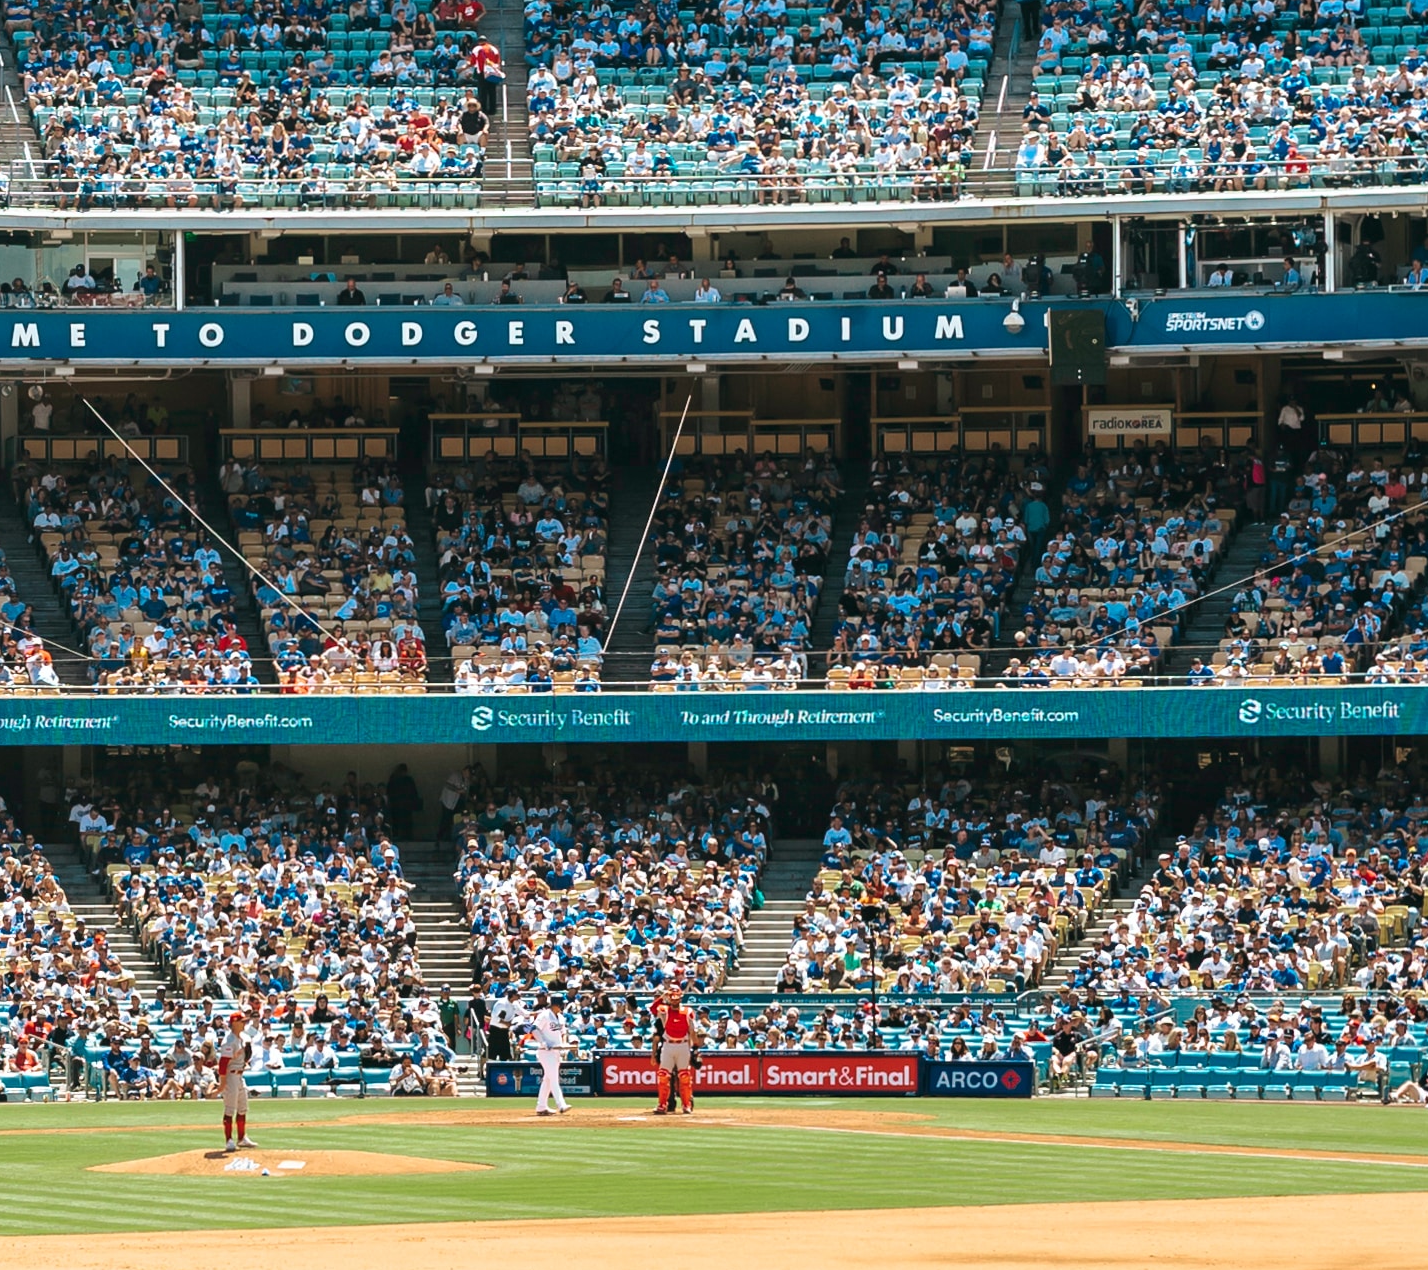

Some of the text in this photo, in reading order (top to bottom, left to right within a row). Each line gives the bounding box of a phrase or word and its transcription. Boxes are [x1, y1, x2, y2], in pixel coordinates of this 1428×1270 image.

[151, 321, 225, 348] TO
[291, 319, 575, 347] DODGER
[642, 314, 965, 346] STADIUM
[1166, 317, 1245, 332] SPORTSNET
[498, 710, 567, 730] Security
[680, 710, 698, 726] To
[702, 709, 728, 725] and
[732, 709, 793, 728] Through
[933, 707, 1079, 726] SecurityBenefit.com
[1266, 702, 1335, 723] Security
[169, 714, 313, 731] SecurityBenefit.com
[605, 1064, 755, 1085] SmaFinal.
[767, 1065, 915, 1086] Smart&Final.
[936, 1071, 998, 1089] ARCO
